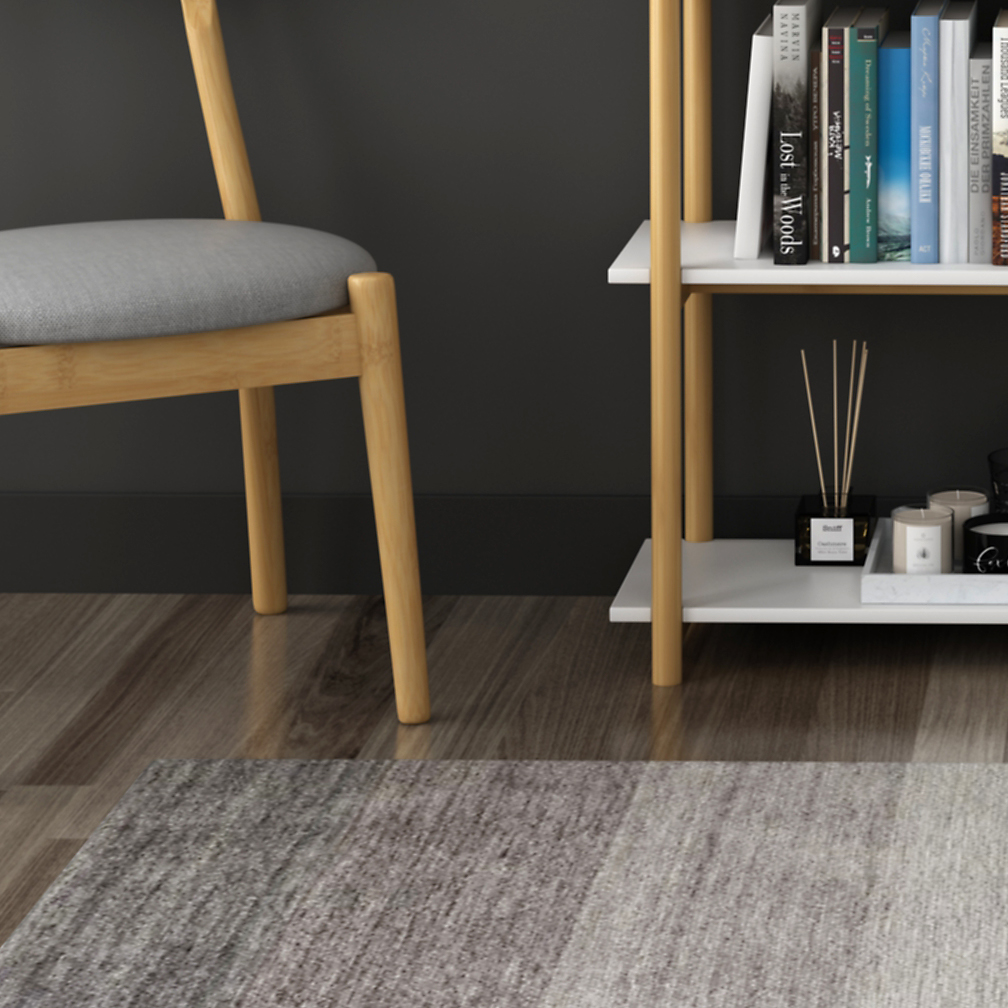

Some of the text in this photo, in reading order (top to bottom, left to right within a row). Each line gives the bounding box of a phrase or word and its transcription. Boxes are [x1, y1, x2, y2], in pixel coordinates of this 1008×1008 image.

[780, 13, 789, 61] NAVINA
[791, 13, 800, 61] MARVIN
[864, 59, 872, 101] Dreaming
[865, 102, 872, 111] of
[981, 64, 991, 194] DER PRIMZAHLEN
[971, 79, 980, 194] DIE EINSAMKEIT
[780, 131, 803, 255] Lost in the Woods
